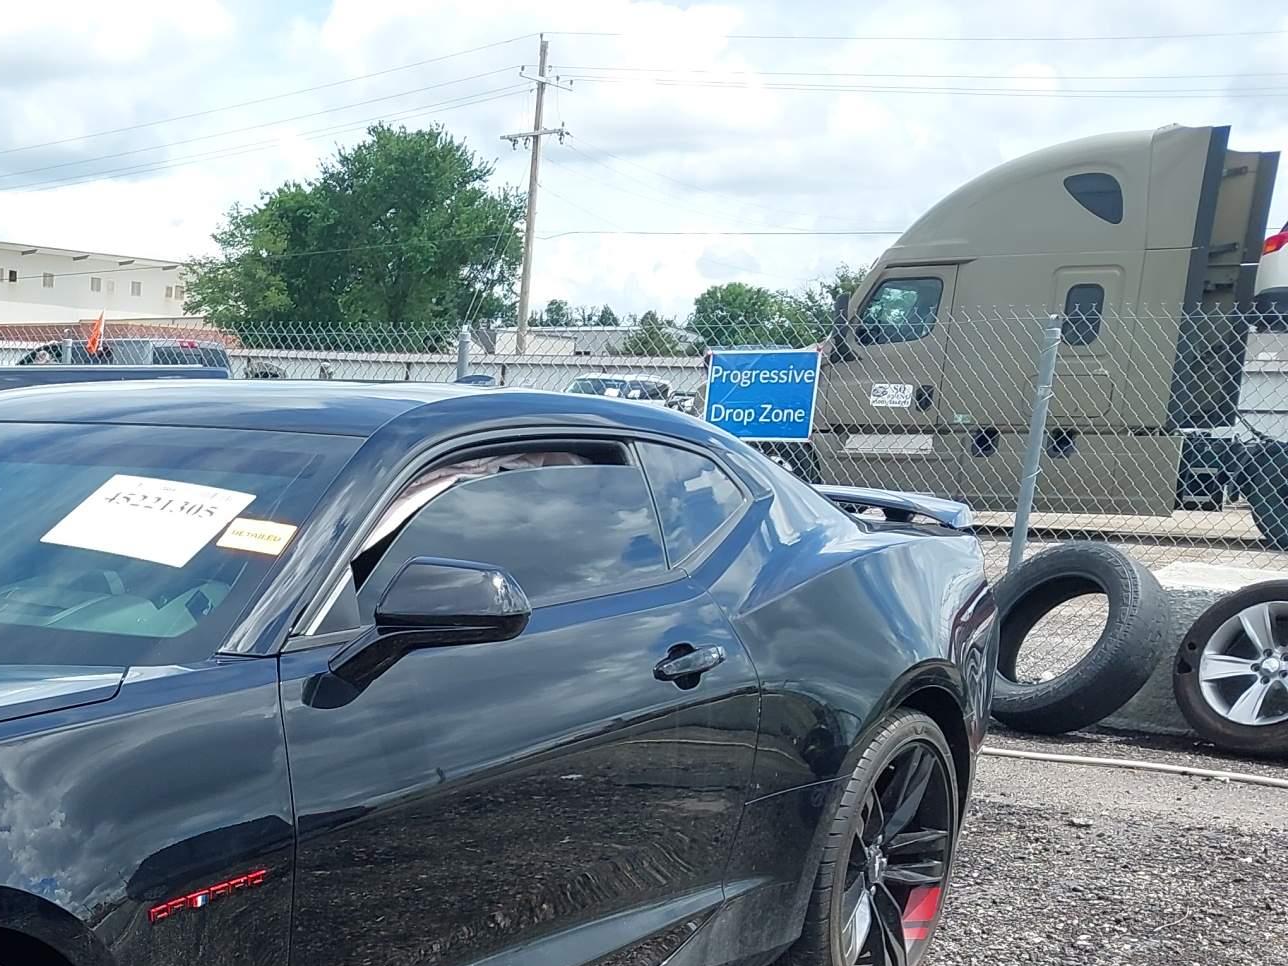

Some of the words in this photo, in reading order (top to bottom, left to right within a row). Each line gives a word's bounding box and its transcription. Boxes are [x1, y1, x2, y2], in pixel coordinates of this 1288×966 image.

[711, 365, 815, 386] Progressive
[711, 404, 755, 425] Drop
[759, 405, 805, 422] Zone
[106, 491, 218, 518] 45221305
